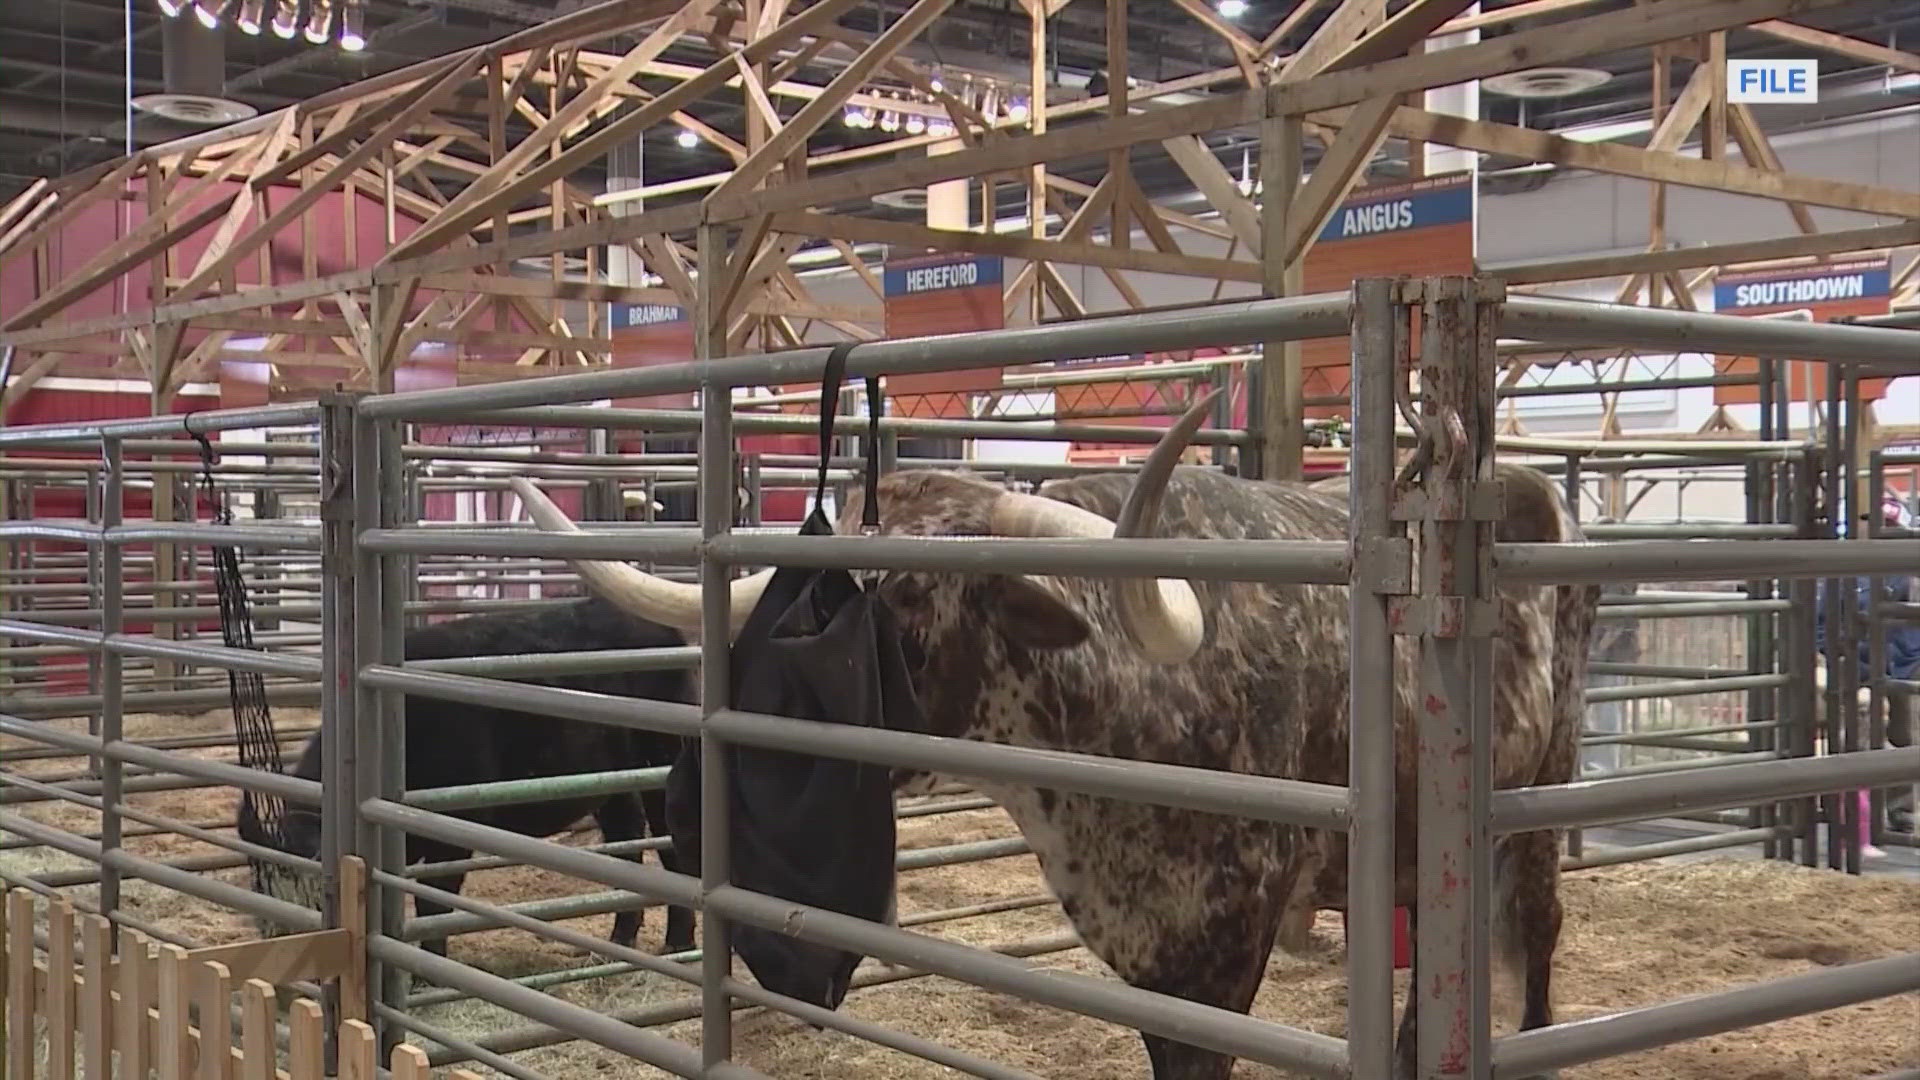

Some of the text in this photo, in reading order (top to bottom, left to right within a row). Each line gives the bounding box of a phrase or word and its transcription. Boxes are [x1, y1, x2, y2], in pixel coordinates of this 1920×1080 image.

[1343, 199, 1413, 236] ANGUS
[907, 262, 977, 292] HEREFORD
[1736, 274, 1864, 307] SOUTHDOWN
[628, 304, 678, 326] BRAHMAN
